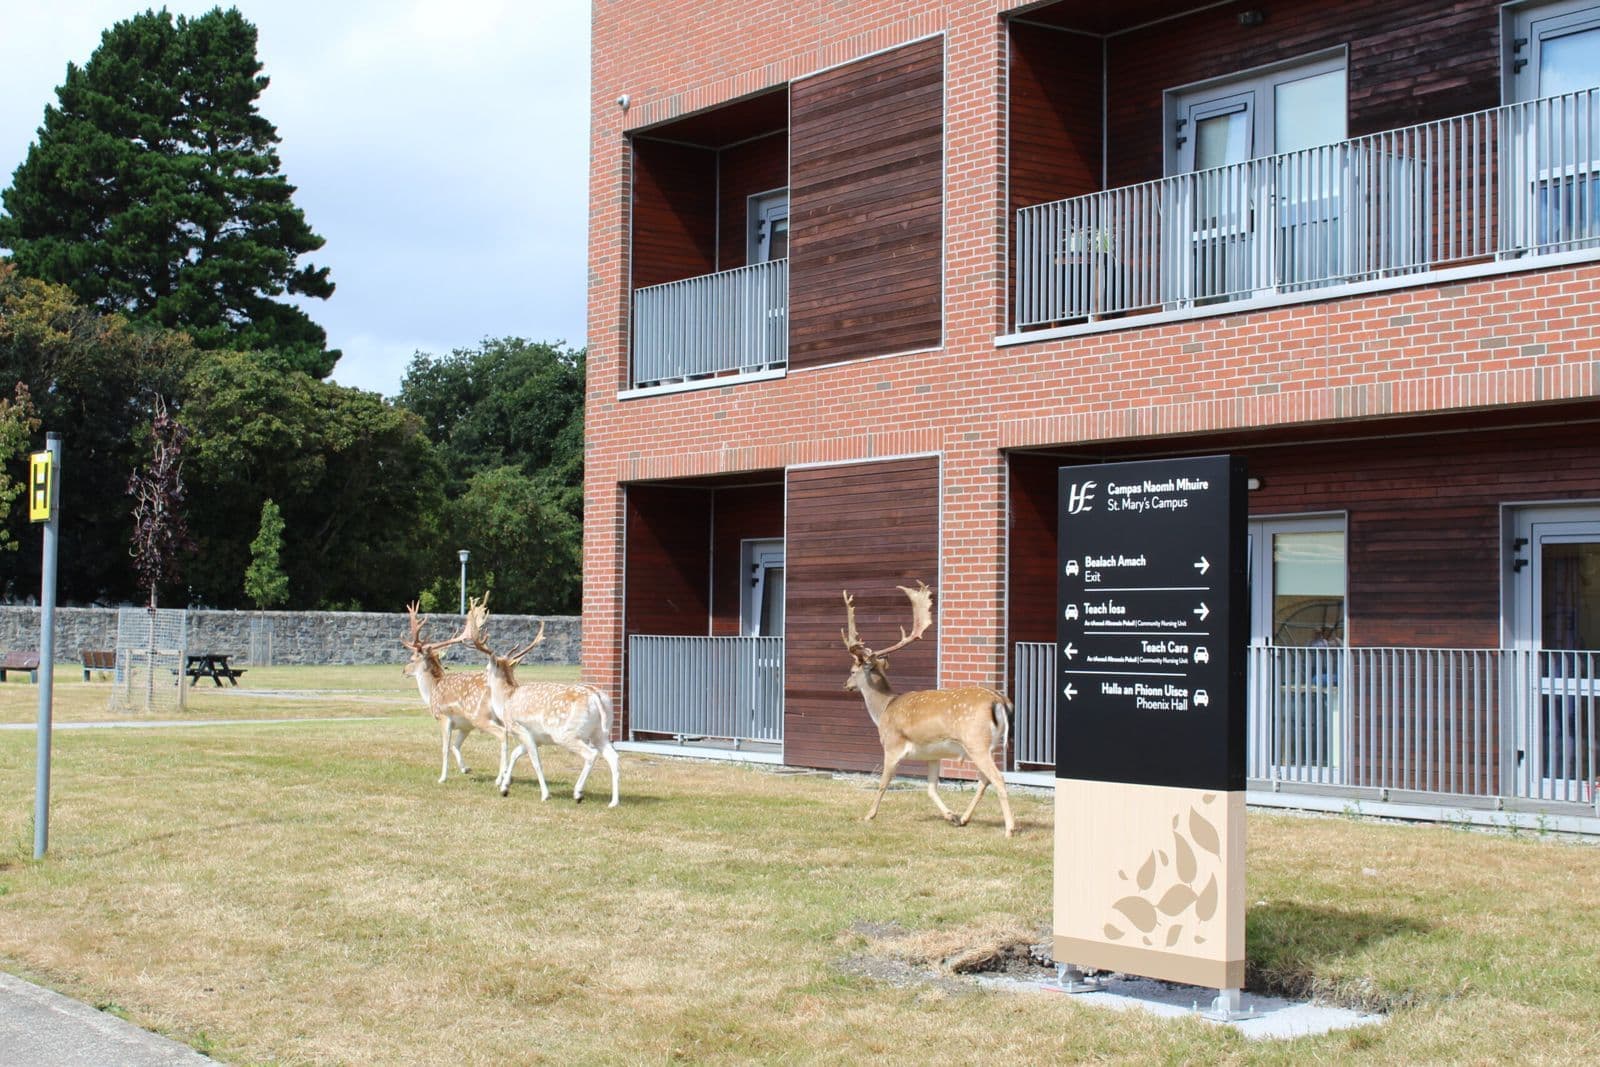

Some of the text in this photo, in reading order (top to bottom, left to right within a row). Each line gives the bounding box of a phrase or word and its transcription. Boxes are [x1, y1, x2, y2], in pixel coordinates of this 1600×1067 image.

[33, 462, 49, 510] H
[1107, 477, 1209, 497] Campas Naomh Mhuire
[1107, 496, 1188, 513] St. Mary's Campus
[1085, 554, 1146, 568] Bealach Amach
[1085, 571, 1101, 582] Exit
[1084, 602, 1107, 614] Teach
[1141, 641, 1189, 654] Teach Cara
[1102, 682, 1188, 697] Halla an Fhionn Uisce
[1136, 697, 1188, 711] Phoenix Hall
